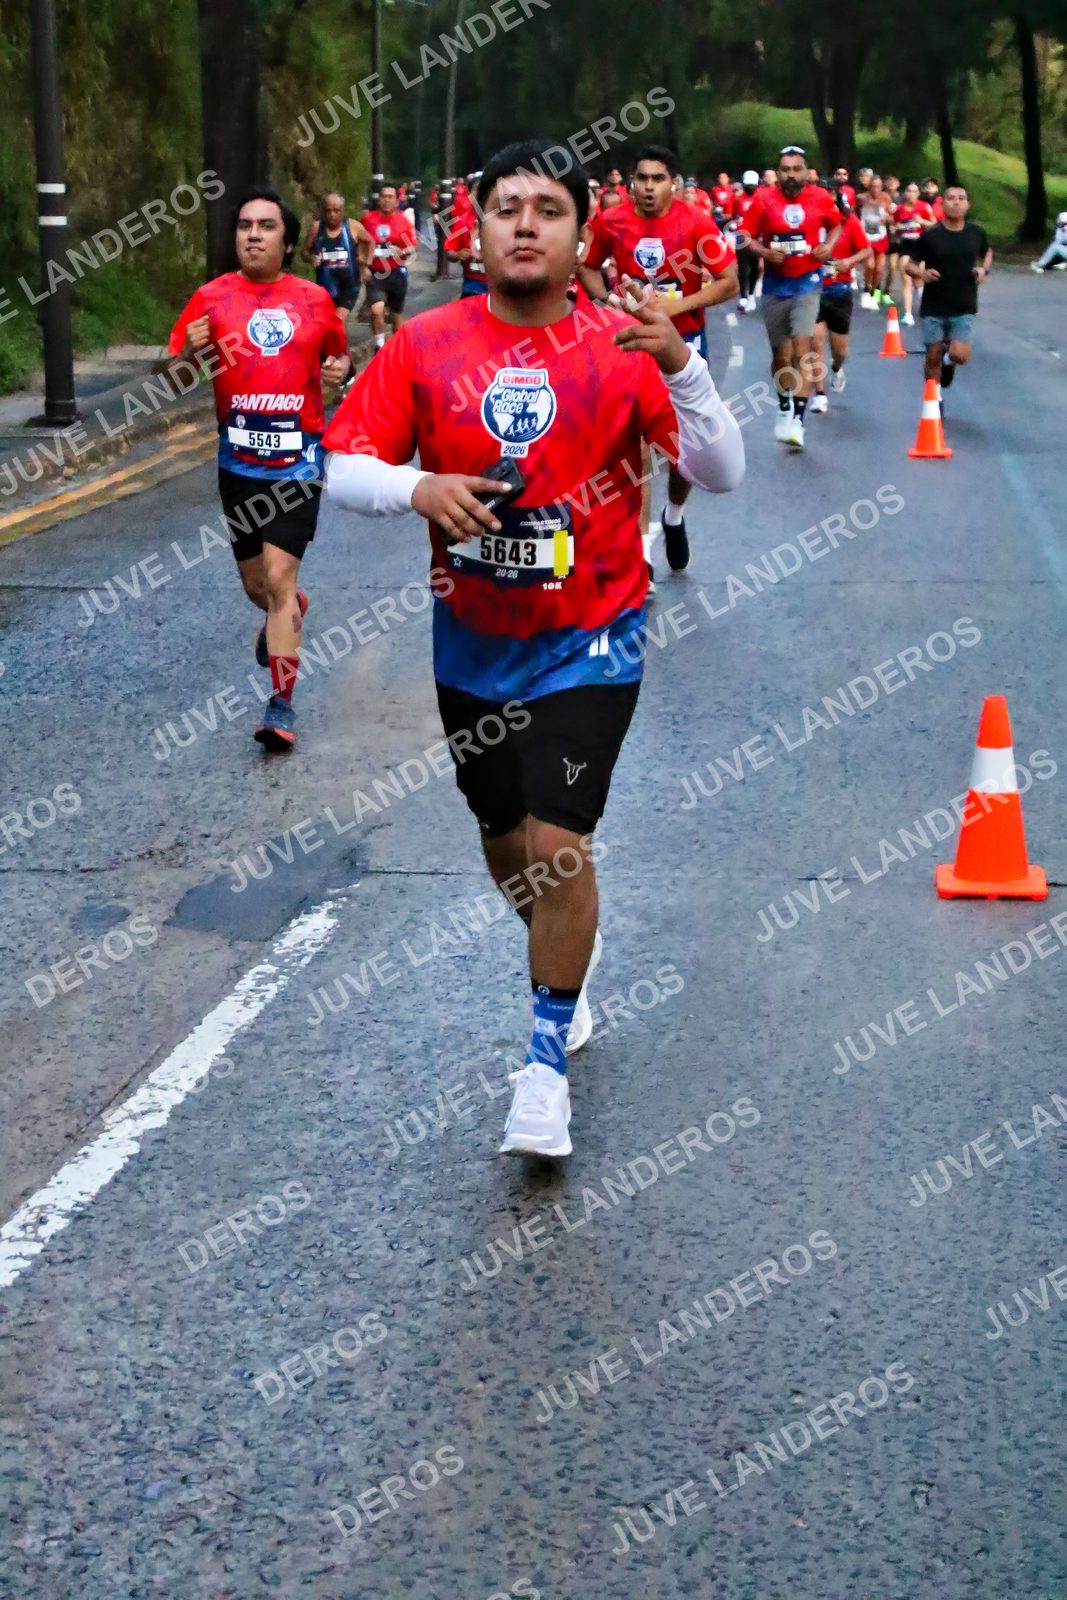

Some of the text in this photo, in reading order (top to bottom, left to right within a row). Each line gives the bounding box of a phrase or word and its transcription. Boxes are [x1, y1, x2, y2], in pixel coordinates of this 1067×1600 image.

[503, 375, 541, 384] BIMBO
[231, 393, 304, 411] SANTIAGO
[501, 388, 540, 403] Global
[492, 400, 524, 413] Race
[248, 432, 281, 448] 5543
[503, 445, 526, 455] 2026
[480, 536, 536, 566] 5643
[542, 582, 562, 590] 10K
